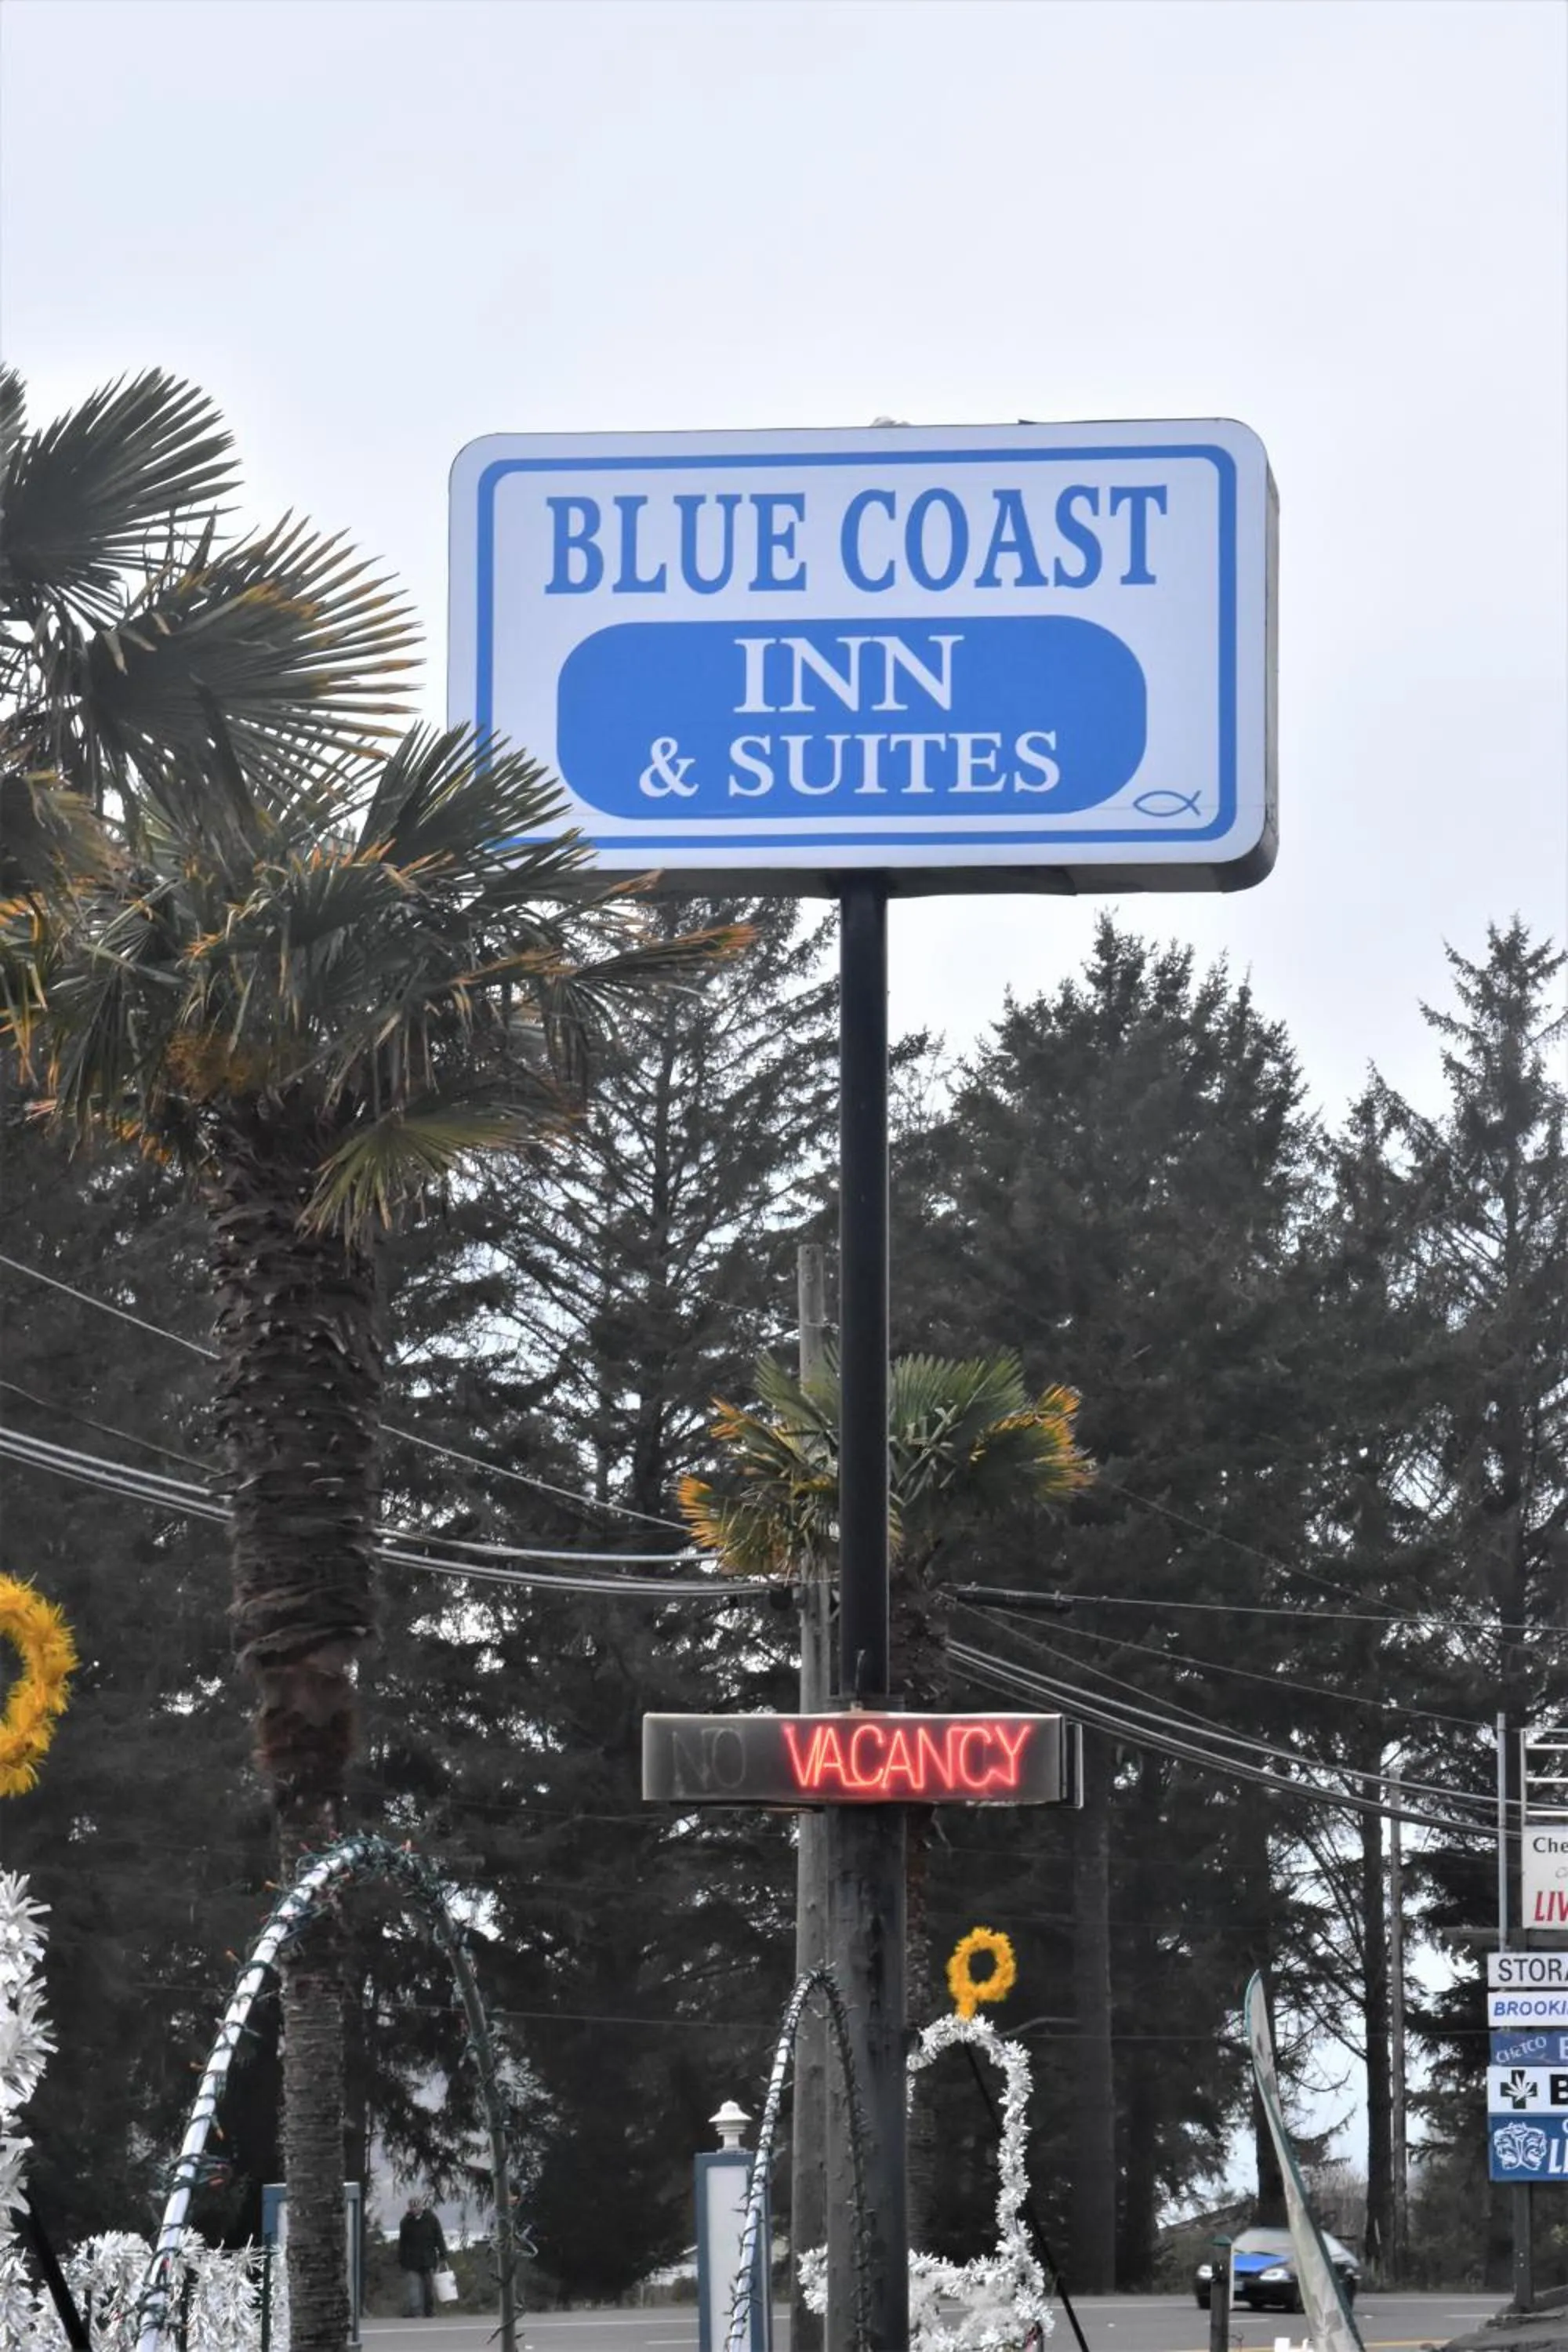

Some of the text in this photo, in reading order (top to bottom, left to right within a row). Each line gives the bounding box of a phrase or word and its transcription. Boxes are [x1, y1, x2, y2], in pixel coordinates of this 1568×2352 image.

[544, 484, 1168, 594] BLUE COAST
[733, 633, 964, 714] INN
[639, 730, 1061, 799] & SUITES
[672, 1723, 1032, 1794] NO VACANCY
[1498, 1958, 1568, 1982] STOR
[1494, 2000, 1568, 2016] BROOKI
